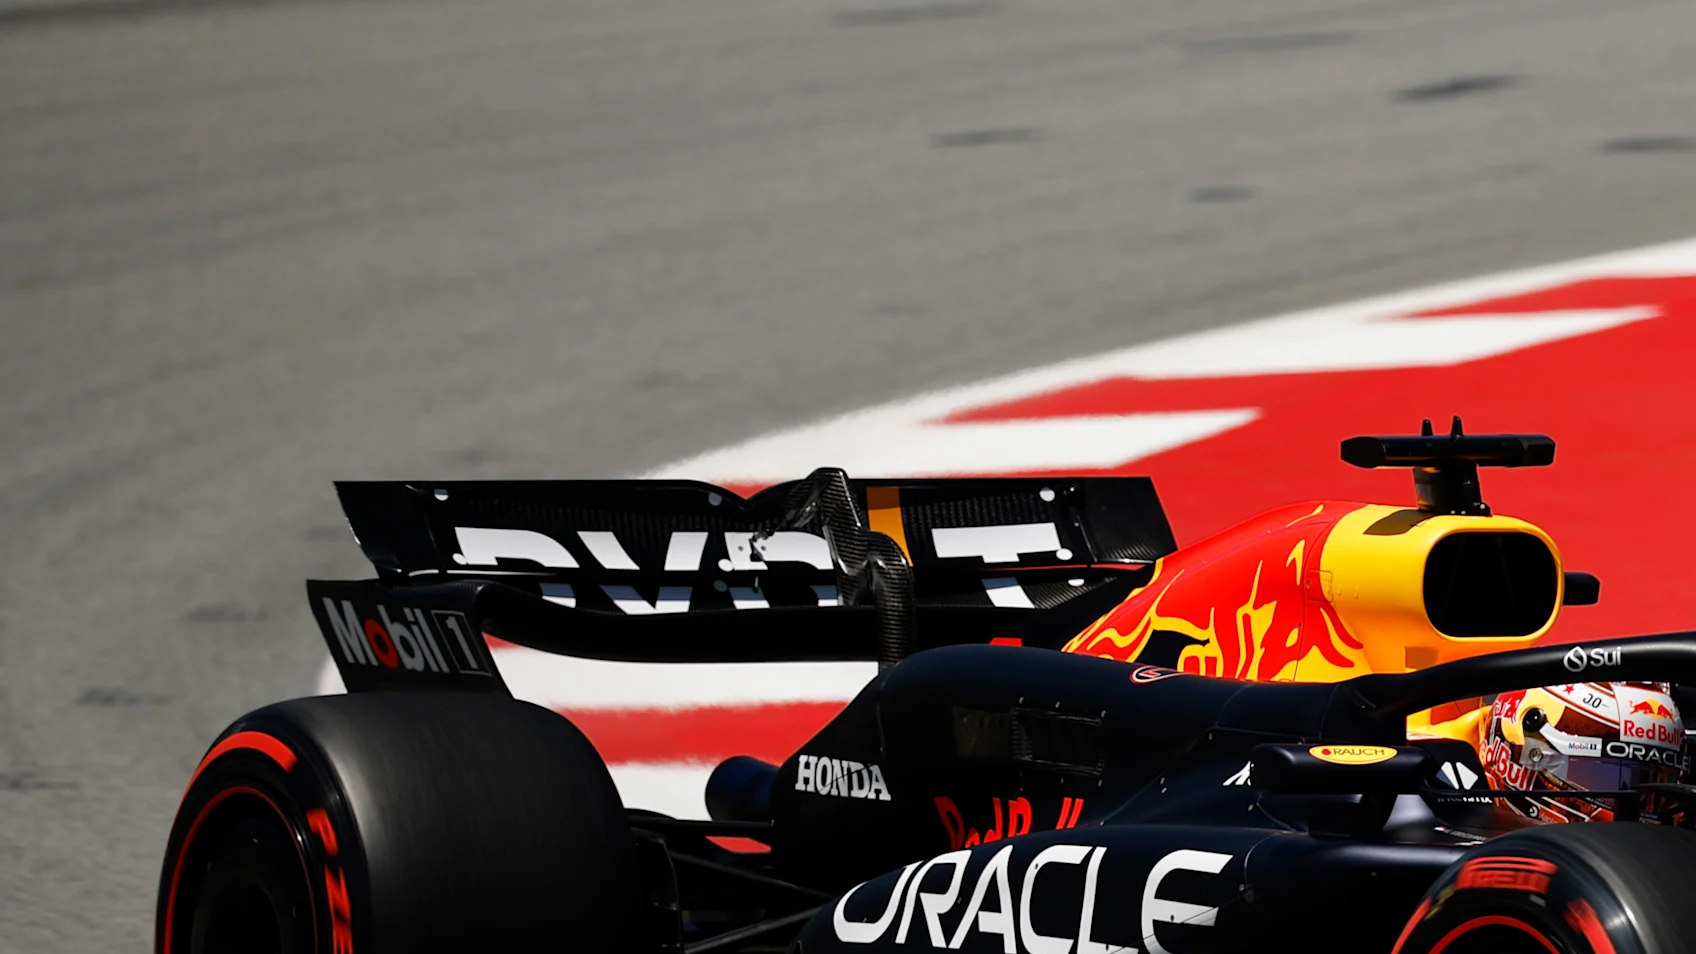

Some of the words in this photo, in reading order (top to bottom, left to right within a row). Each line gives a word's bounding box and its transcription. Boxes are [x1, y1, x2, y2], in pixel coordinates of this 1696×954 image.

[322, 596, 450, 674] Mobil
[443, 614, 481, 671] 1
[1590, 646, 1622, 667] Sui
[1623, 719, 1656, 740] Red
[1332, 747, 1386, 757] RAUCH
[1606, 741, 1689, 772] ORACLE
[795, 754, 892, 801] HONDA
[306, 808, 339, 856] P
